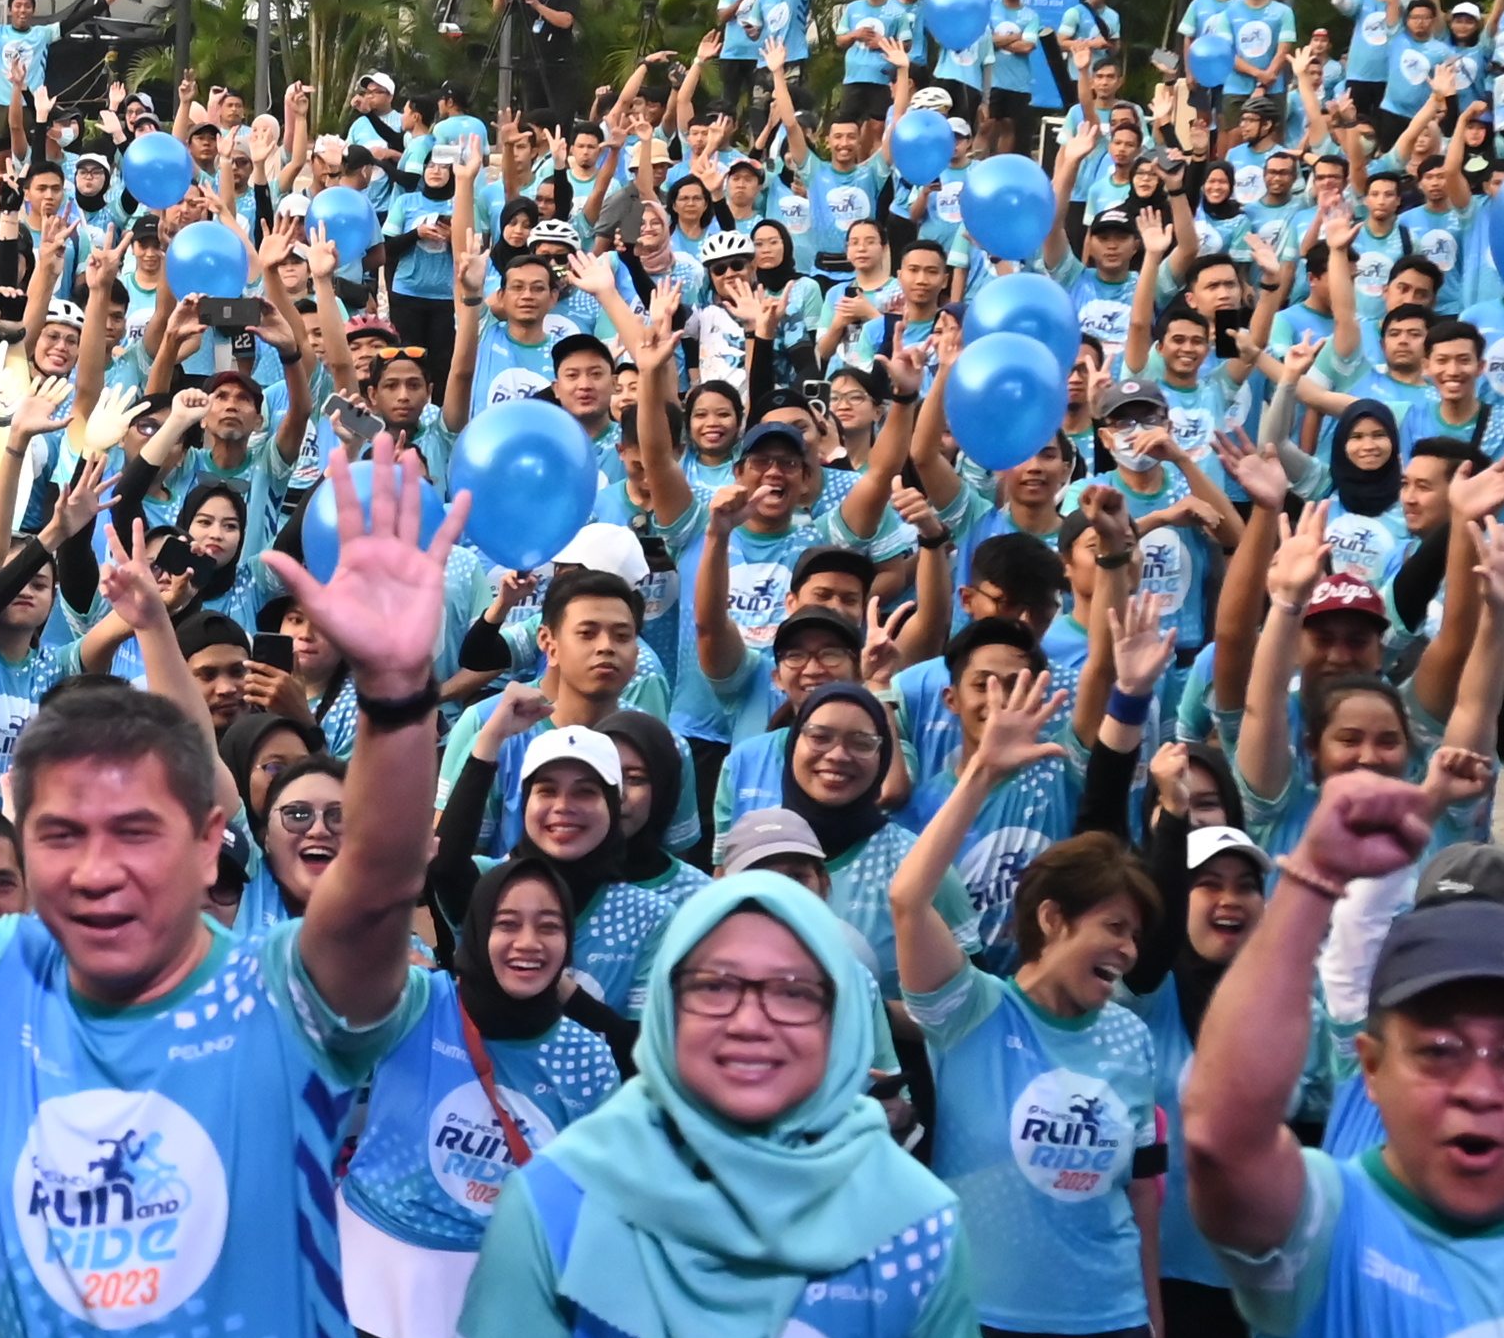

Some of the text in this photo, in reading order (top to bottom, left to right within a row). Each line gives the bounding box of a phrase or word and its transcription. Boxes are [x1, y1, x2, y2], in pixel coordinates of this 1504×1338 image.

[235, 333, 252, 349] 22
[1310, 581, 1373, 604] Erigo
[82, 1265, 161, 1310] 2023
